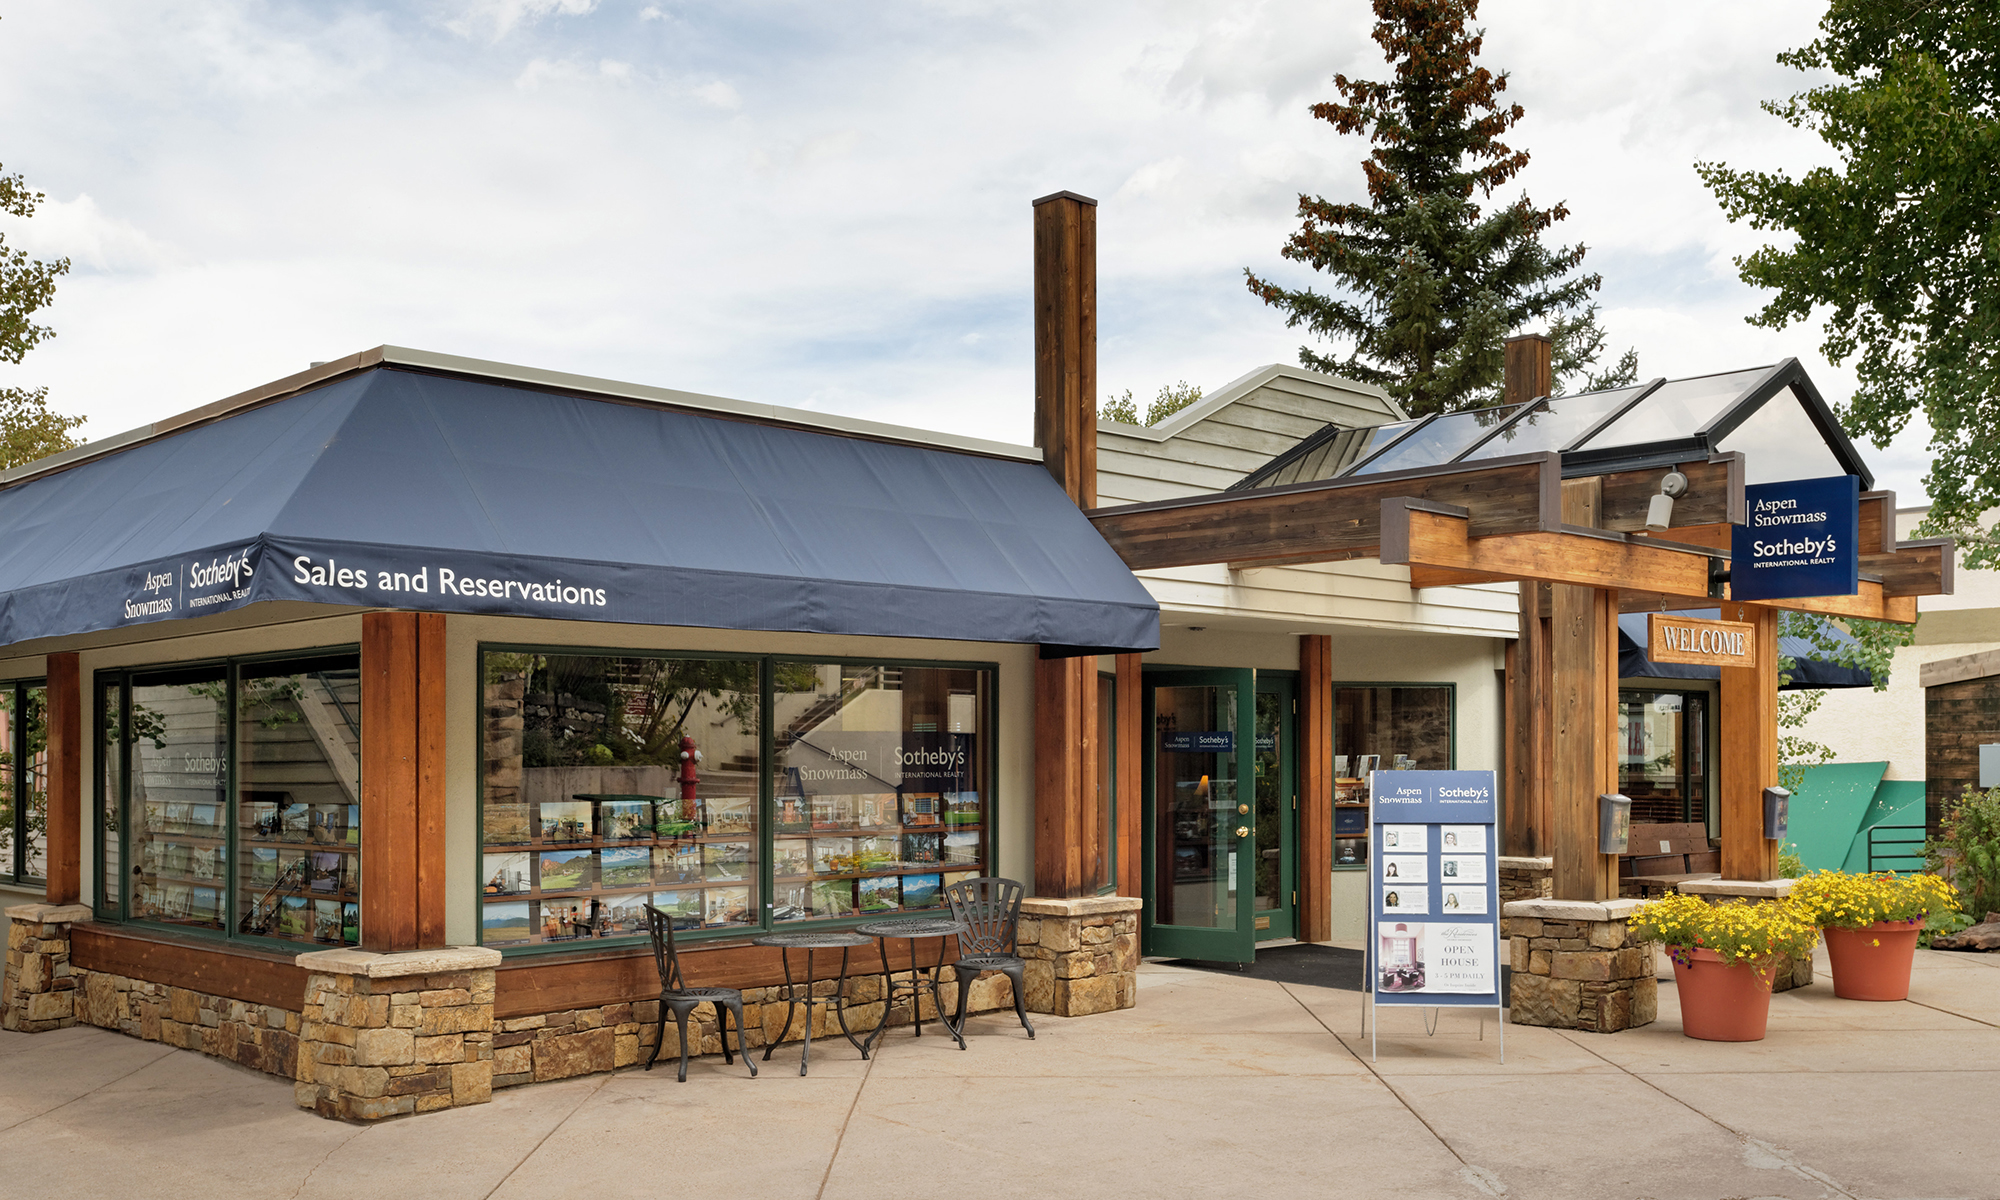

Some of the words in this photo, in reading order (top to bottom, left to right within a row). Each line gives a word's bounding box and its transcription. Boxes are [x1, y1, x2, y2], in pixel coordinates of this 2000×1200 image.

[1754, 498, 1797, 514] Aspen
[1754, 511, 1827, 528] Snowmass
[1753, 534, 1836, 558] Sotheby's
[189, 549, 254, 589] Sotheby's
[1753, 559, 1808, 569] INTERNATIONAL
[1810, 557, 1836, 565] REALTY
[143, 571, 173, 595] Aspen
[293, 555, 368, 589] Sales
[378, 566, 428, 593] and
[439, 567, 607, 607] Reservations
[189, 591, 233, 608] INTERNATIONAL
[232, 586, 252, 600] REALT
[124, 597, 173, 619] Snowmass
[1661, 626, 1745, 656] WELCOME
[1199, 736, 1229, 745] Sotheby's
[184, 750, 227, 778] Sotheby's
[828, 746, 868, 765] Aspen
[894, 745, 965, 771] Sotheby's
[800, 765, 868, 781] Snowmass
[894, 771, 943, 779] INTERNATIONAL
[943, 770, 964, 778] REALTY
[1379, 795, 1423, 804] Snowmass
[1396, 787, 1422, 797] Aspen
[1439, 787, 1489, 800] Sotheby's
[1444, 945, 1474, 954] OPEN
[1441, 958, 1479, 966] HOUSE
